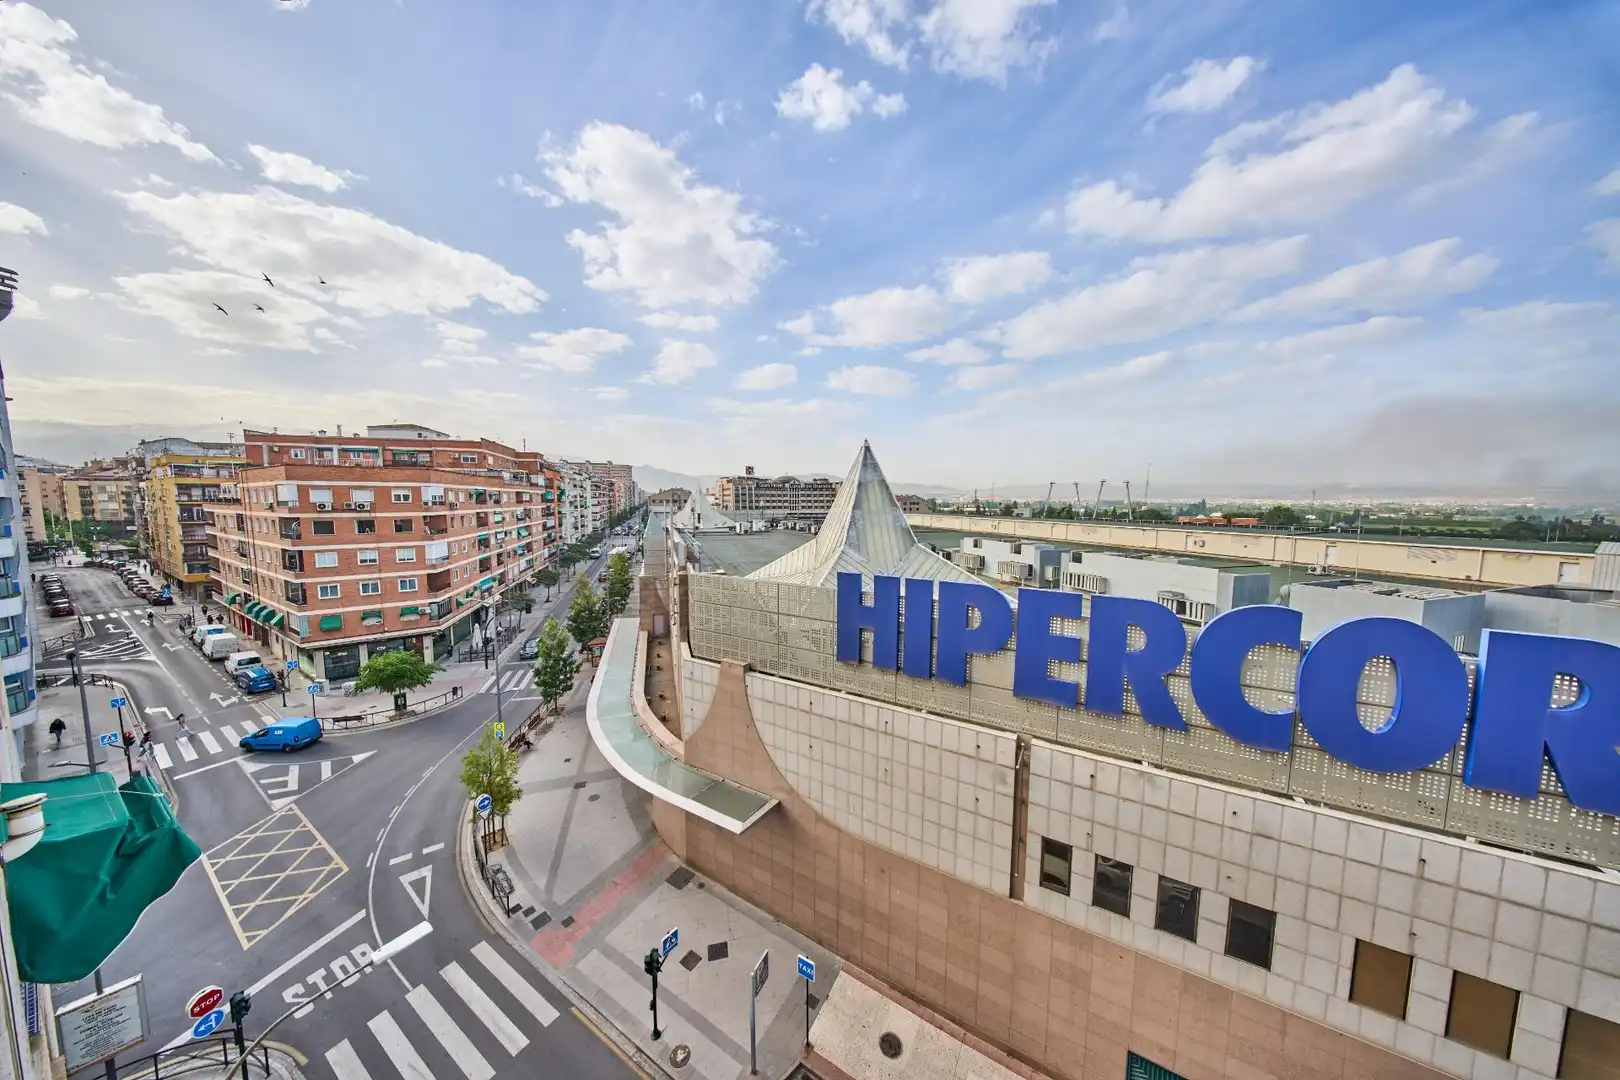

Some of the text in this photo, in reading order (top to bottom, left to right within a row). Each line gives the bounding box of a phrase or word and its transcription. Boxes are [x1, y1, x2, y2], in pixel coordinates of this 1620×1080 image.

[836, 571, 1620, 816] HIPERCOR
[282, 943, 374, 1019] STOP
[799, 963, 814, 975] TAXI
[193, 993, 220, 1014] STOP
